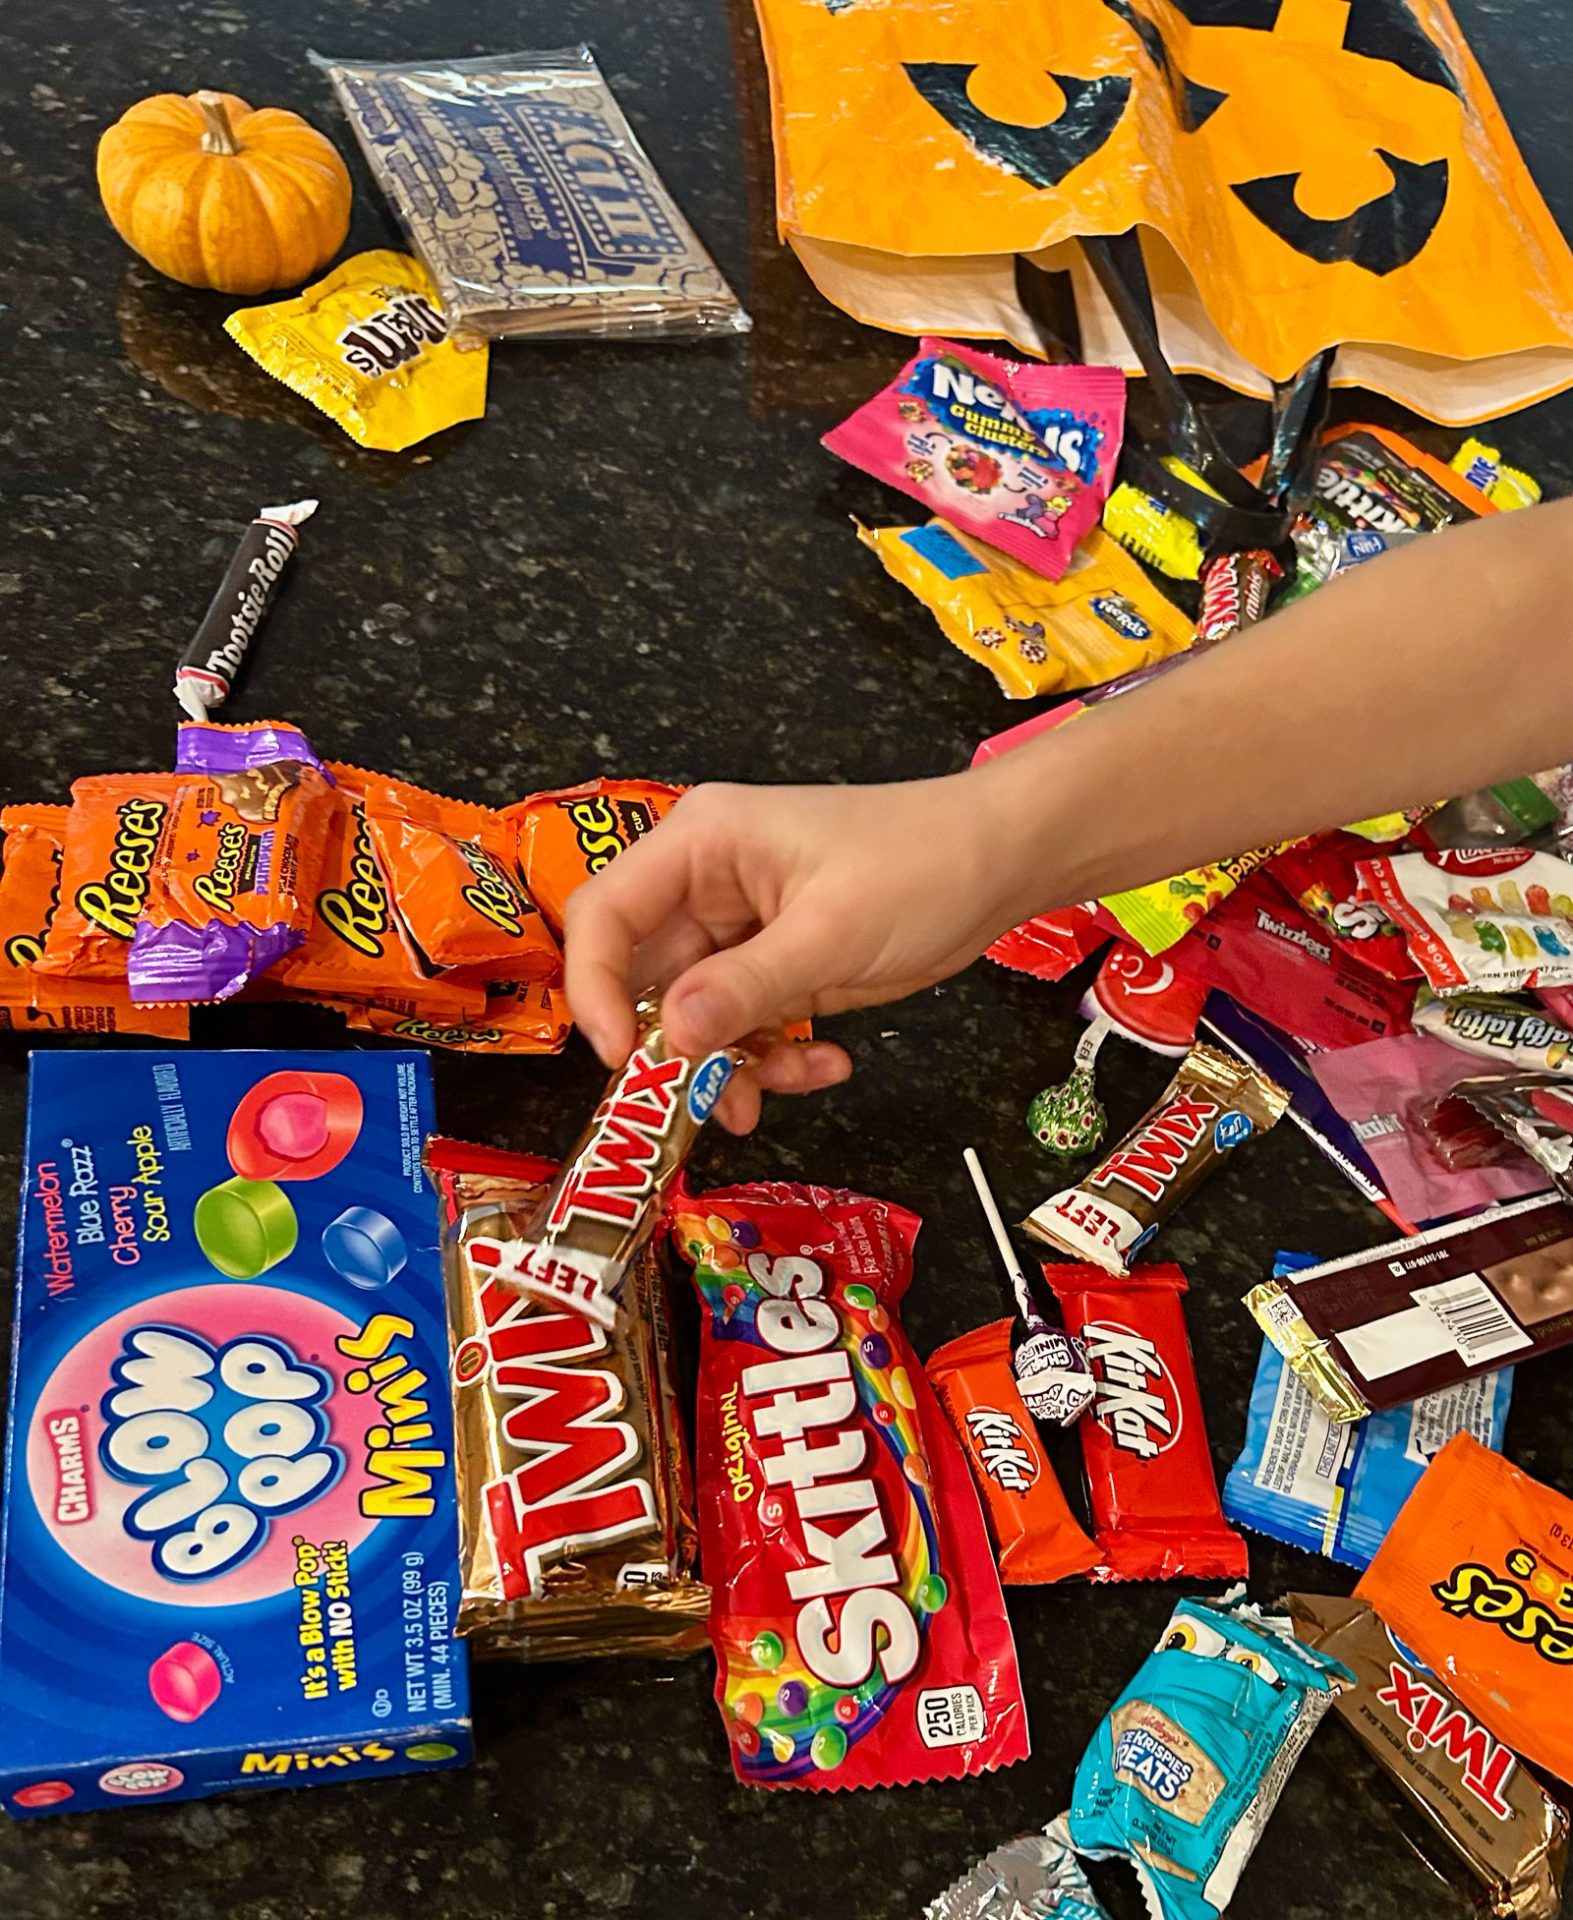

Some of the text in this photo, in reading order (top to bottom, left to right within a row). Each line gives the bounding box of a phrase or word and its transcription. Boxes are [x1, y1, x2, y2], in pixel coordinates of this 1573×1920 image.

[553, 110, 628, 195] ACT
[510, 177, 553, 233] Lovers
[950, 405, 1038, 443] Gummy
[964, 421, 1051, 459] Clusters
[206, 528, 294, 680] Tootsie Roll
[1245, 574, 1262, 621] minis
[79, 800, 163, 938] Reese's
[195, 824, 248, 913] Reese's
[1257, 907, 1331, 960] Twizzlers
[1425, 942, 1457, 983] LAVOR
[1452, 1010, 1569, 1049] affy Taffy
[152, 1063, 192, 1152] ARTIFICIALLY FLAVORED
[547, 1049, 689, 1230] TWIX
[1091, 1094, 1219, 1201] TWIX
[126, 1125, 171, 1243] Sour Apple
[34, 1162, 74, 1297] Watermelon
[77, 1200, 104, 1246] Blue
[108, 1187, 140, 1266] Cherry
[1055, 1195, 1121, 1246] LEFT
[514, 1249, 598, 1301] LEFT
[1034, 1337, 1066, 1354] MINI
[50, 1415, 91, 1522] CHARMS
[1319, 1456, 1334, 1473] THIS
[1324, 1438, 1338, 1456] UNIT
[295, 1543, 328, 1700] It's a Blow Pop
[322, 1540, 357, 1691] with NO Stick!
[402, 1552, 426, 1712] NET WT 3.5 OZ (99 g)
[427, 1582, 456, 1709] (MIN. 44 PIECES)
[925, 1697, 953, 1737] 250
[952, 1693, 966, 1735] CALORIES
[966, 1693, 977, 1730] PER PACK
[1360, 1704, 1381, 1725] SALE
[1134, 1729, 1193, 1782] KRISPIES
[1378, 1663, 1516, 1820] TWIX
